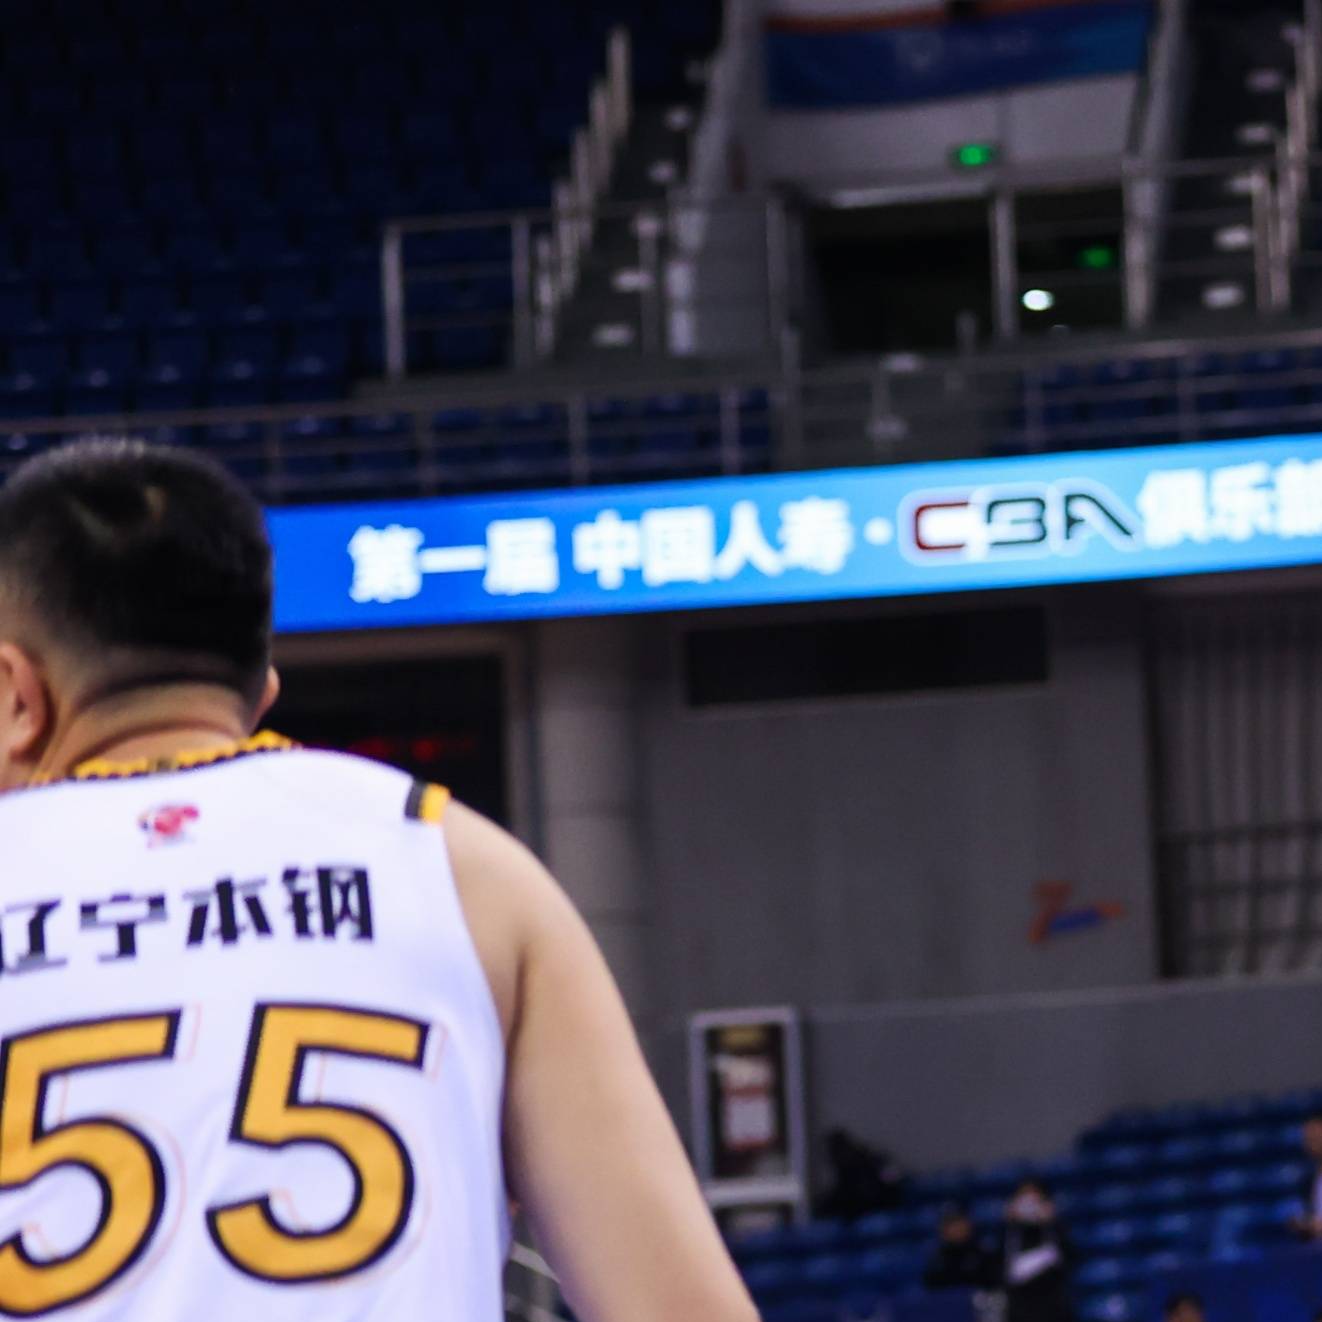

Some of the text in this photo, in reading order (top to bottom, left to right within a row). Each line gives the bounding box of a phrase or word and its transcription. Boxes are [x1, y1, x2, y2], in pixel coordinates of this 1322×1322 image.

[349, 516, 559, 603] 第一届
[0, 998, 430, 1319] 55
